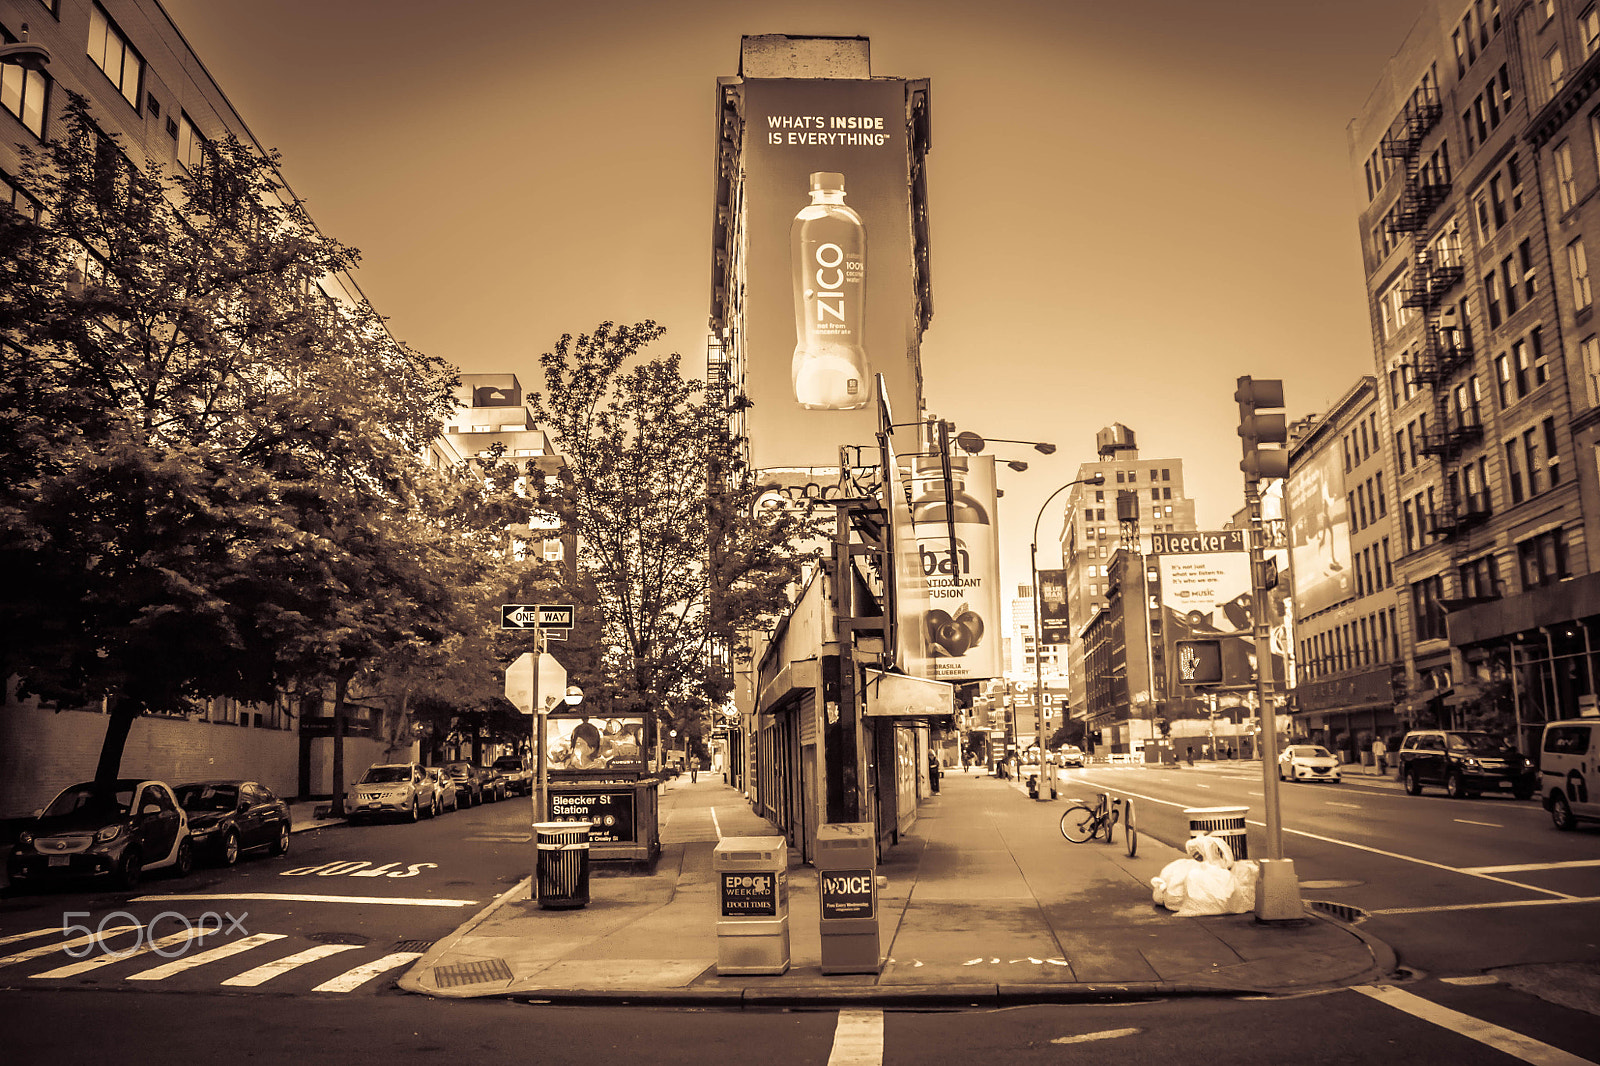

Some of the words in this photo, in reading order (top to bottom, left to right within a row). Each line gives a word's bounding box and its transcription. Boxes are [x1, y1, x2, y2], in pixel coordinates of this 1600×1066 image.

[767, 116, 825, 129] WHAT'S
[830, 116, 884, 130] INSIDE
[768, 132, 783, 145] IS
[815, 243, 845, 322] ZICO
[1153, 533, 1227, 553] Bleecker
[1231, 531, 1242, 543] St
[926, 578, 981, 588] NTIOXDANT
[515, 612, 535, 622] ONE
[544, 612, 566, 622] WAY
[553, 796, 597, 805] Bleecker
[599, 795, 611, 805] St
[553, 805, 588, 814] Station
[279, 860, 439, 878] STOP
[726, 876, 771, 888] EPOCH
[726, 888, 771, 896] WEEKEND
